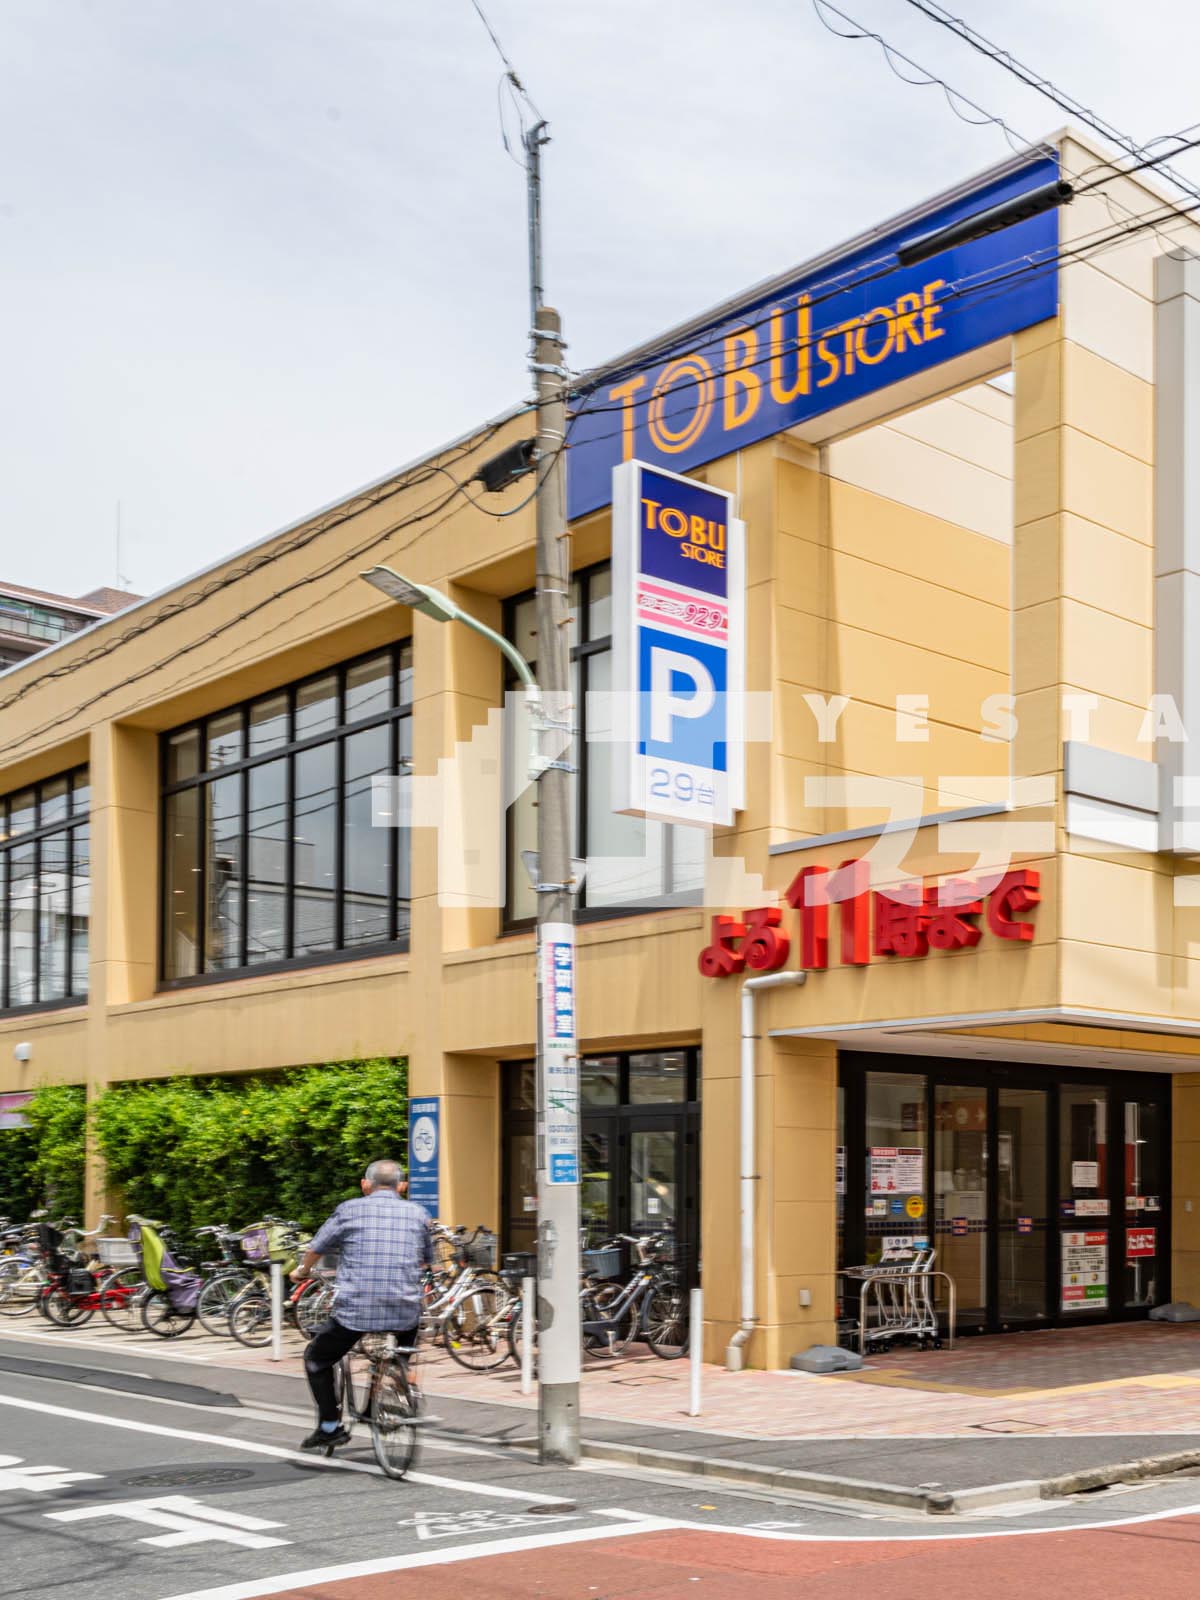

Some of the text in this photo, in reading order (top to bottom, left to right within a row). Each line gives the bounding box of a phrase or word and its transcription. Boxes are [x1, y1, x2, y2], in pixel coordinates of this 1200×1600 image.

[609, 279, 946, 462] TOBU STORE
[641, 498, 727, 547] TOBU
[681, 541, 726, 570] STORE
[684, 603, 722, 630] 929
[650, 646, 717, 744] P
